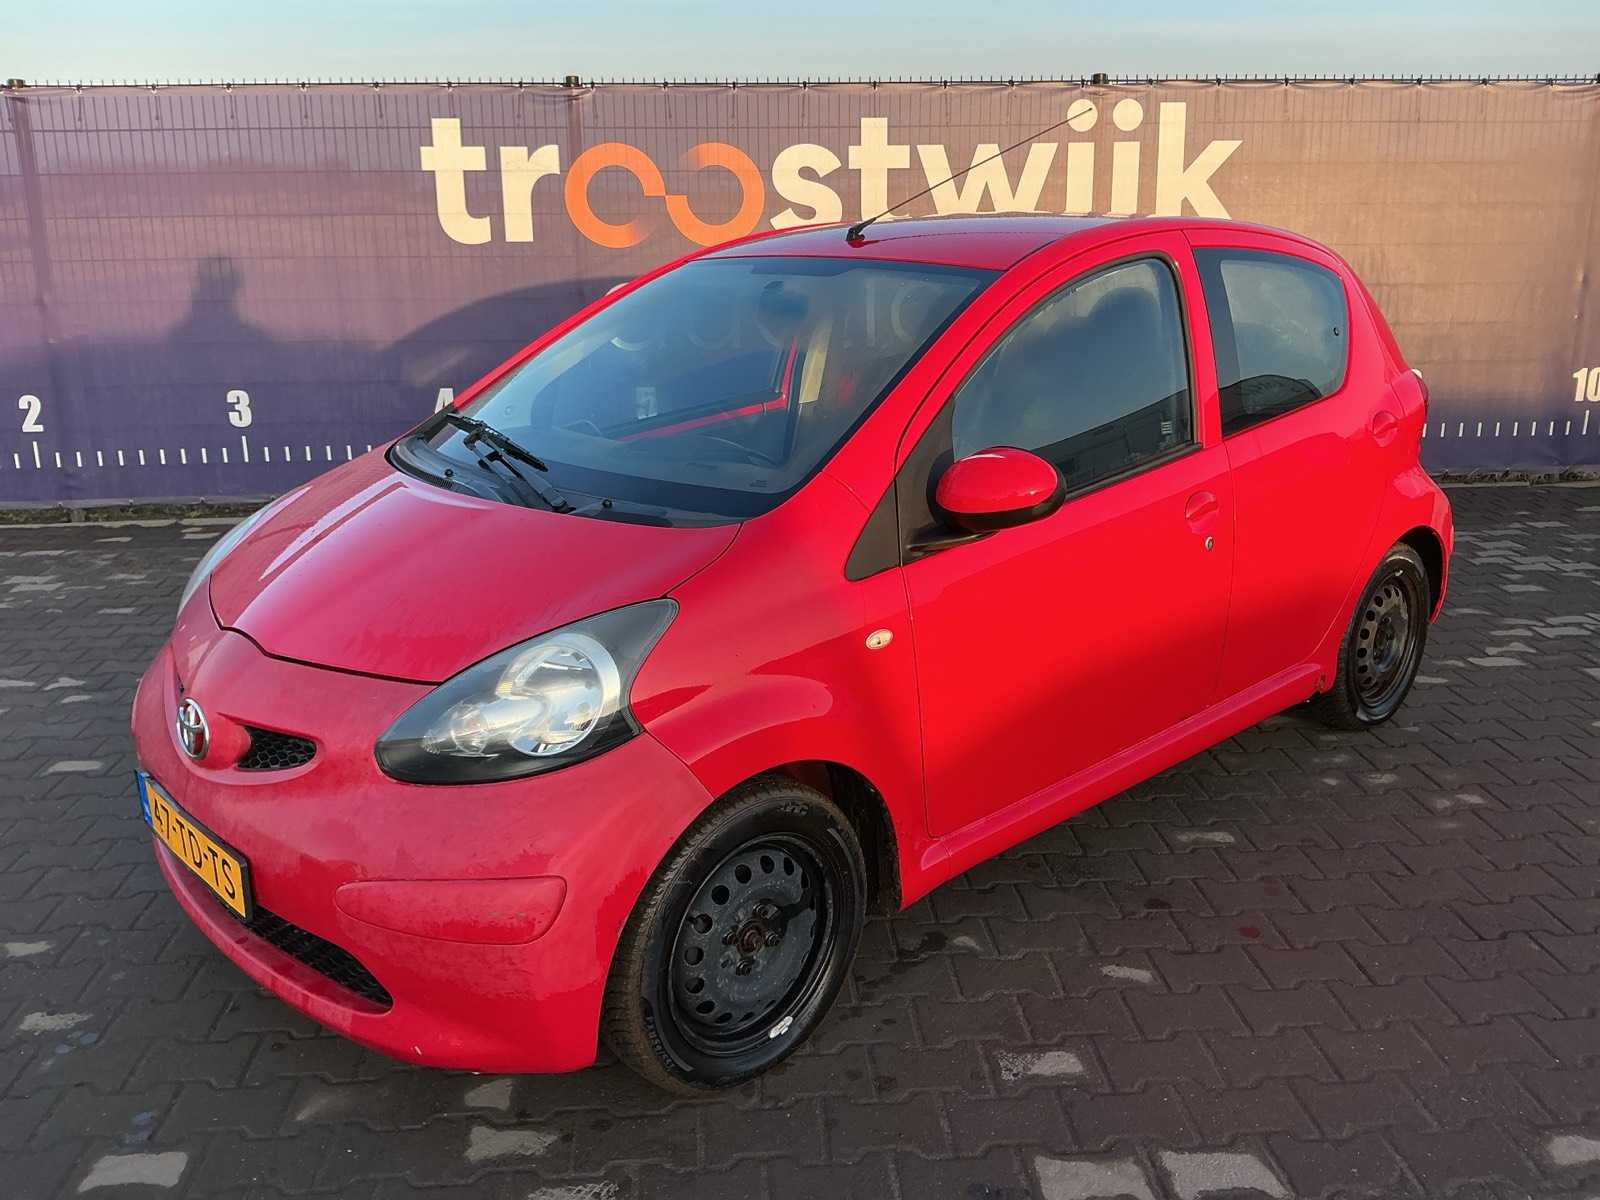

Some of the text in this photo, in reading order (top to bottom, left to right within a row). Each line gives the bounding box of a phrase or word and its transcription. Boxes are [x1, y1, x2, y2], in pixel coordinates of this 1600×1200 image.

[420, 98, 1243, 248] troostwijk
[1572, 367, 1600, 402] 10
[18, 395, 44, 432] 2
[226, 390, 252, 427] 3
[153, 798, 237, 900] 47-TD-TS
